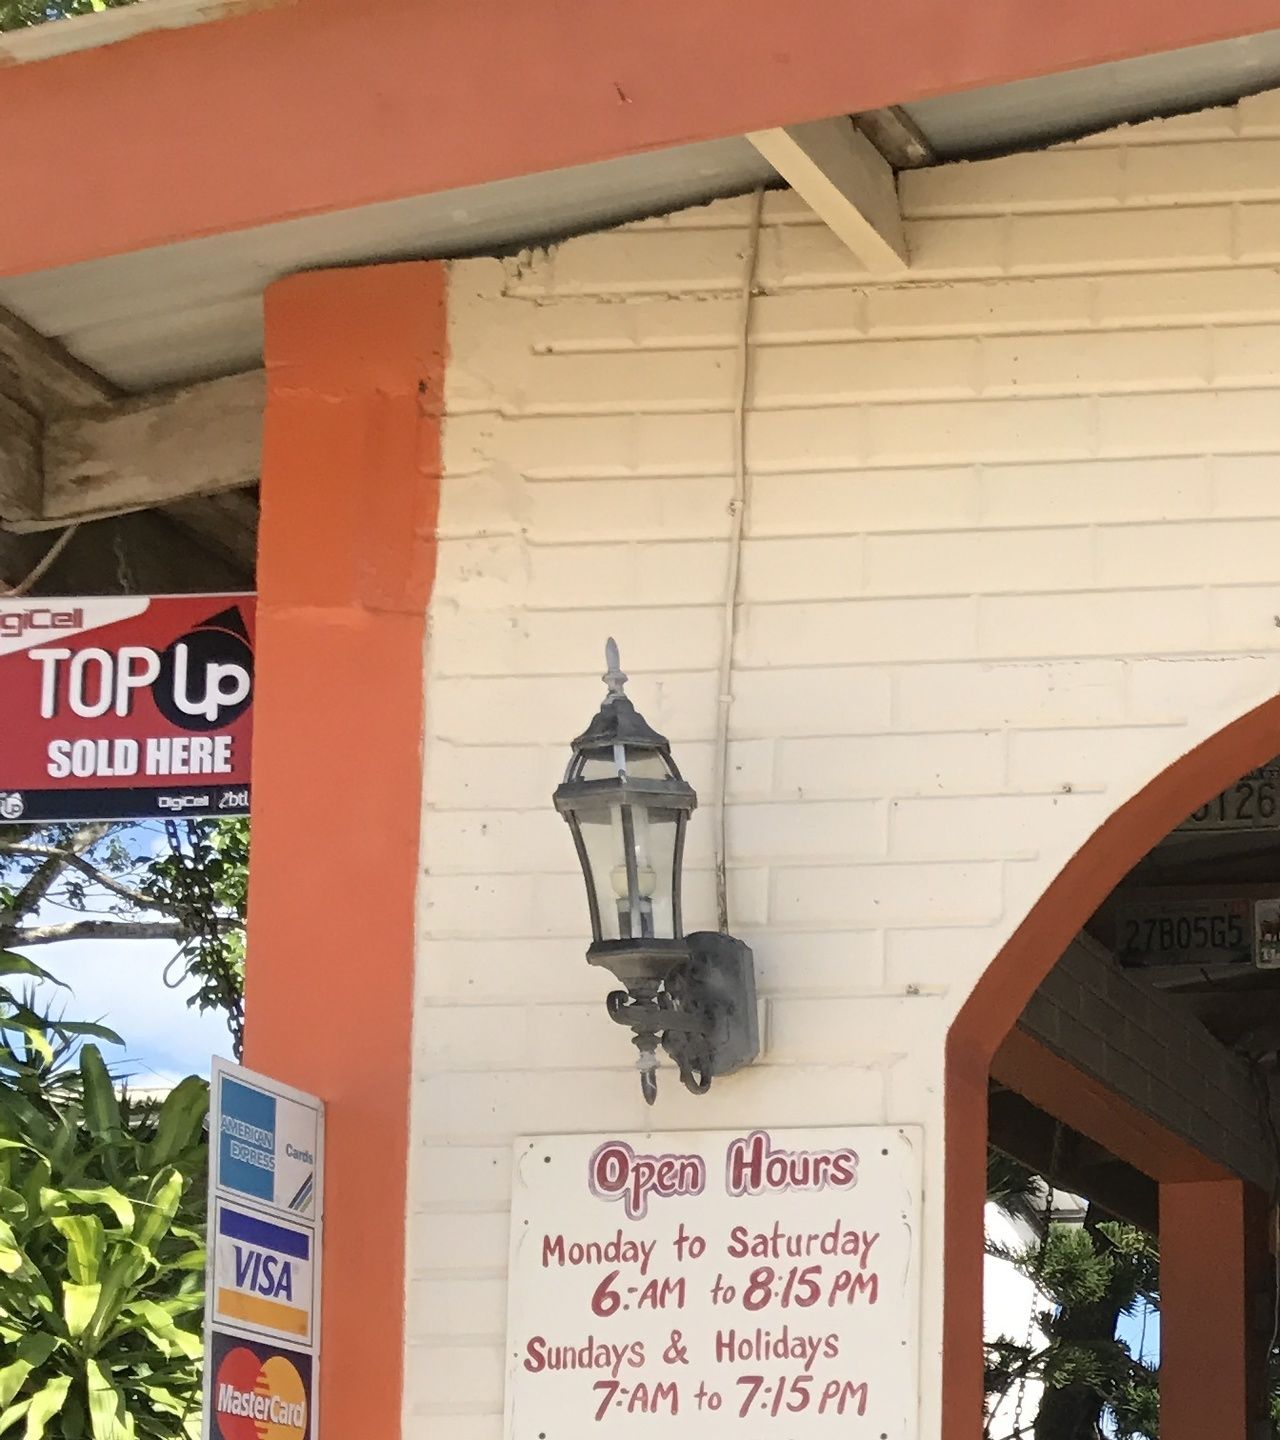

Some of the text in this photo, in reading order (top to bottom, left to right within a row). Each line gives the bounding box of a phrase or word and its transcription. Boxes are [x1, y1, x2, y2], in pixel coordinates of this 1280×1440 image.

[28, 643, 250, 722] TOP Up
[47, 736, 232, 777] SOLD HERE
[220, 1114, 273, 1150] AMERICAN
[286, 1143, 313, 1165] Cards
[230, 1139, 276, 1172] EXPRESS
[595, 1136, 856, 1213] Open Hours
[542, 1219, 880, 1275] Monday to Saturday
[233, 1246, 293, 1301] VISA
[710, 1274, 735, 1304] to
[742, 1265, 822, 1311] 8:15
[828, 1270, 879, 1307] PM
[523, 1325, 839, 1378] Sundays & Holidays
[217, 1383, 305, 1427] MasterCard
[694, 1380, 722, 1411] to
[736, 1375, 813, 1418] 7:15
[818, 1381, 868, 1416] PM
